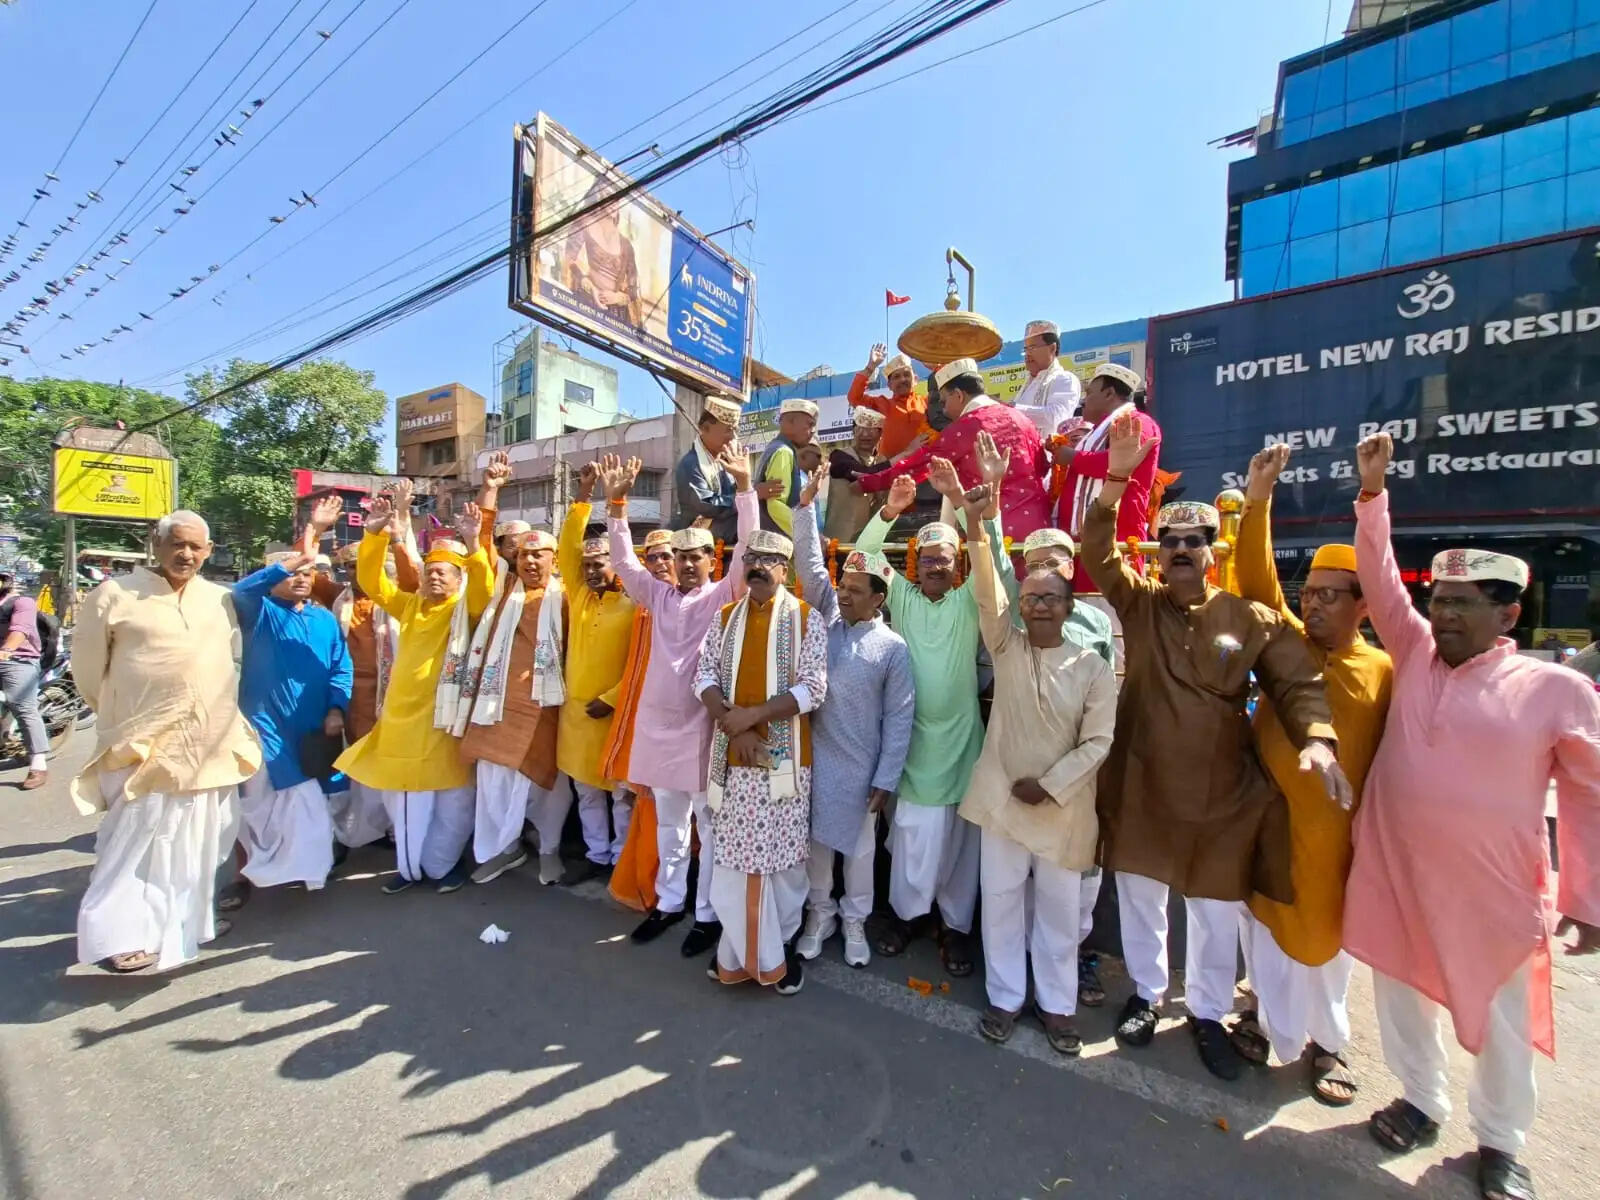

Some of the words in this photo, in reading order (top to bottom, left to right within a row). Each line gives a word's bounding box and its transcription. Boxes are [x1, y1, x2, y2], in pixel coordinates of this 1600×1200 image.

[697, 273, 738, 312] INDRIYA
[677, 310, 701, 342] 35
[1216, 353, 1309, 386] HOTEL
[1320, 338, 1394, 369] NEW
[1405, 326, 1470, 356] RAJ
[1264, 427, 1336, 450] NEW
[1437, 401, 1599, 437] SWEETS
[1330, 460, 1355, 479] &
[1275, 549, 1298, 559] RYANI
